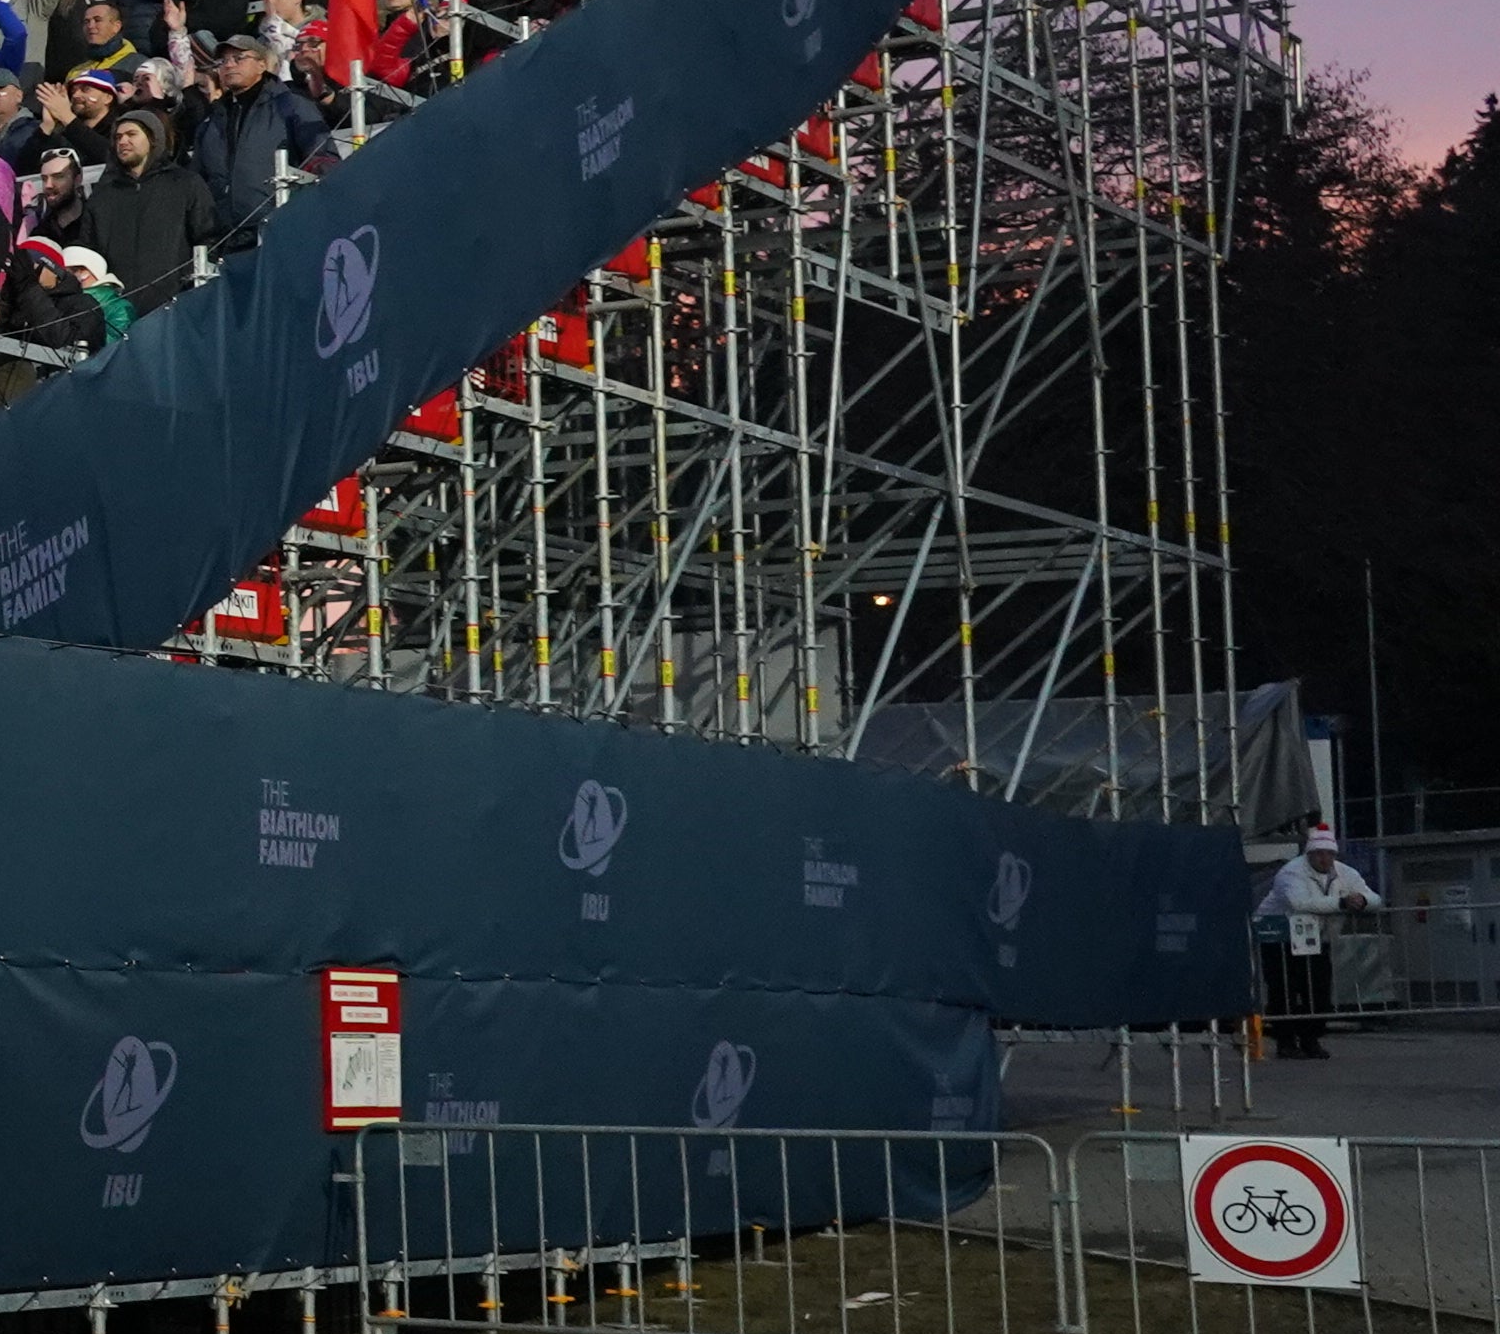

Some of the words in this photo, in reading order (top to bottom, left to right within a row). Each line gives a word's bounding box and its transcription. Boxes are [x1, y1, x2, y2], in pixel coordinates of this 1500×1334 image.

[347, 349, 380, 397] IBU
[0, 515, 89, 597] BIATHLON
[2, 563, 67, 630] FAMILY
[261, 779, 290, 806] THE
[260, 809, 340, 841] BIATHLON
[260, 839, 318, 868] FAMILY
[580, 891, 610, 922] IBU
[102, 1174, 143, 1208] IBU
